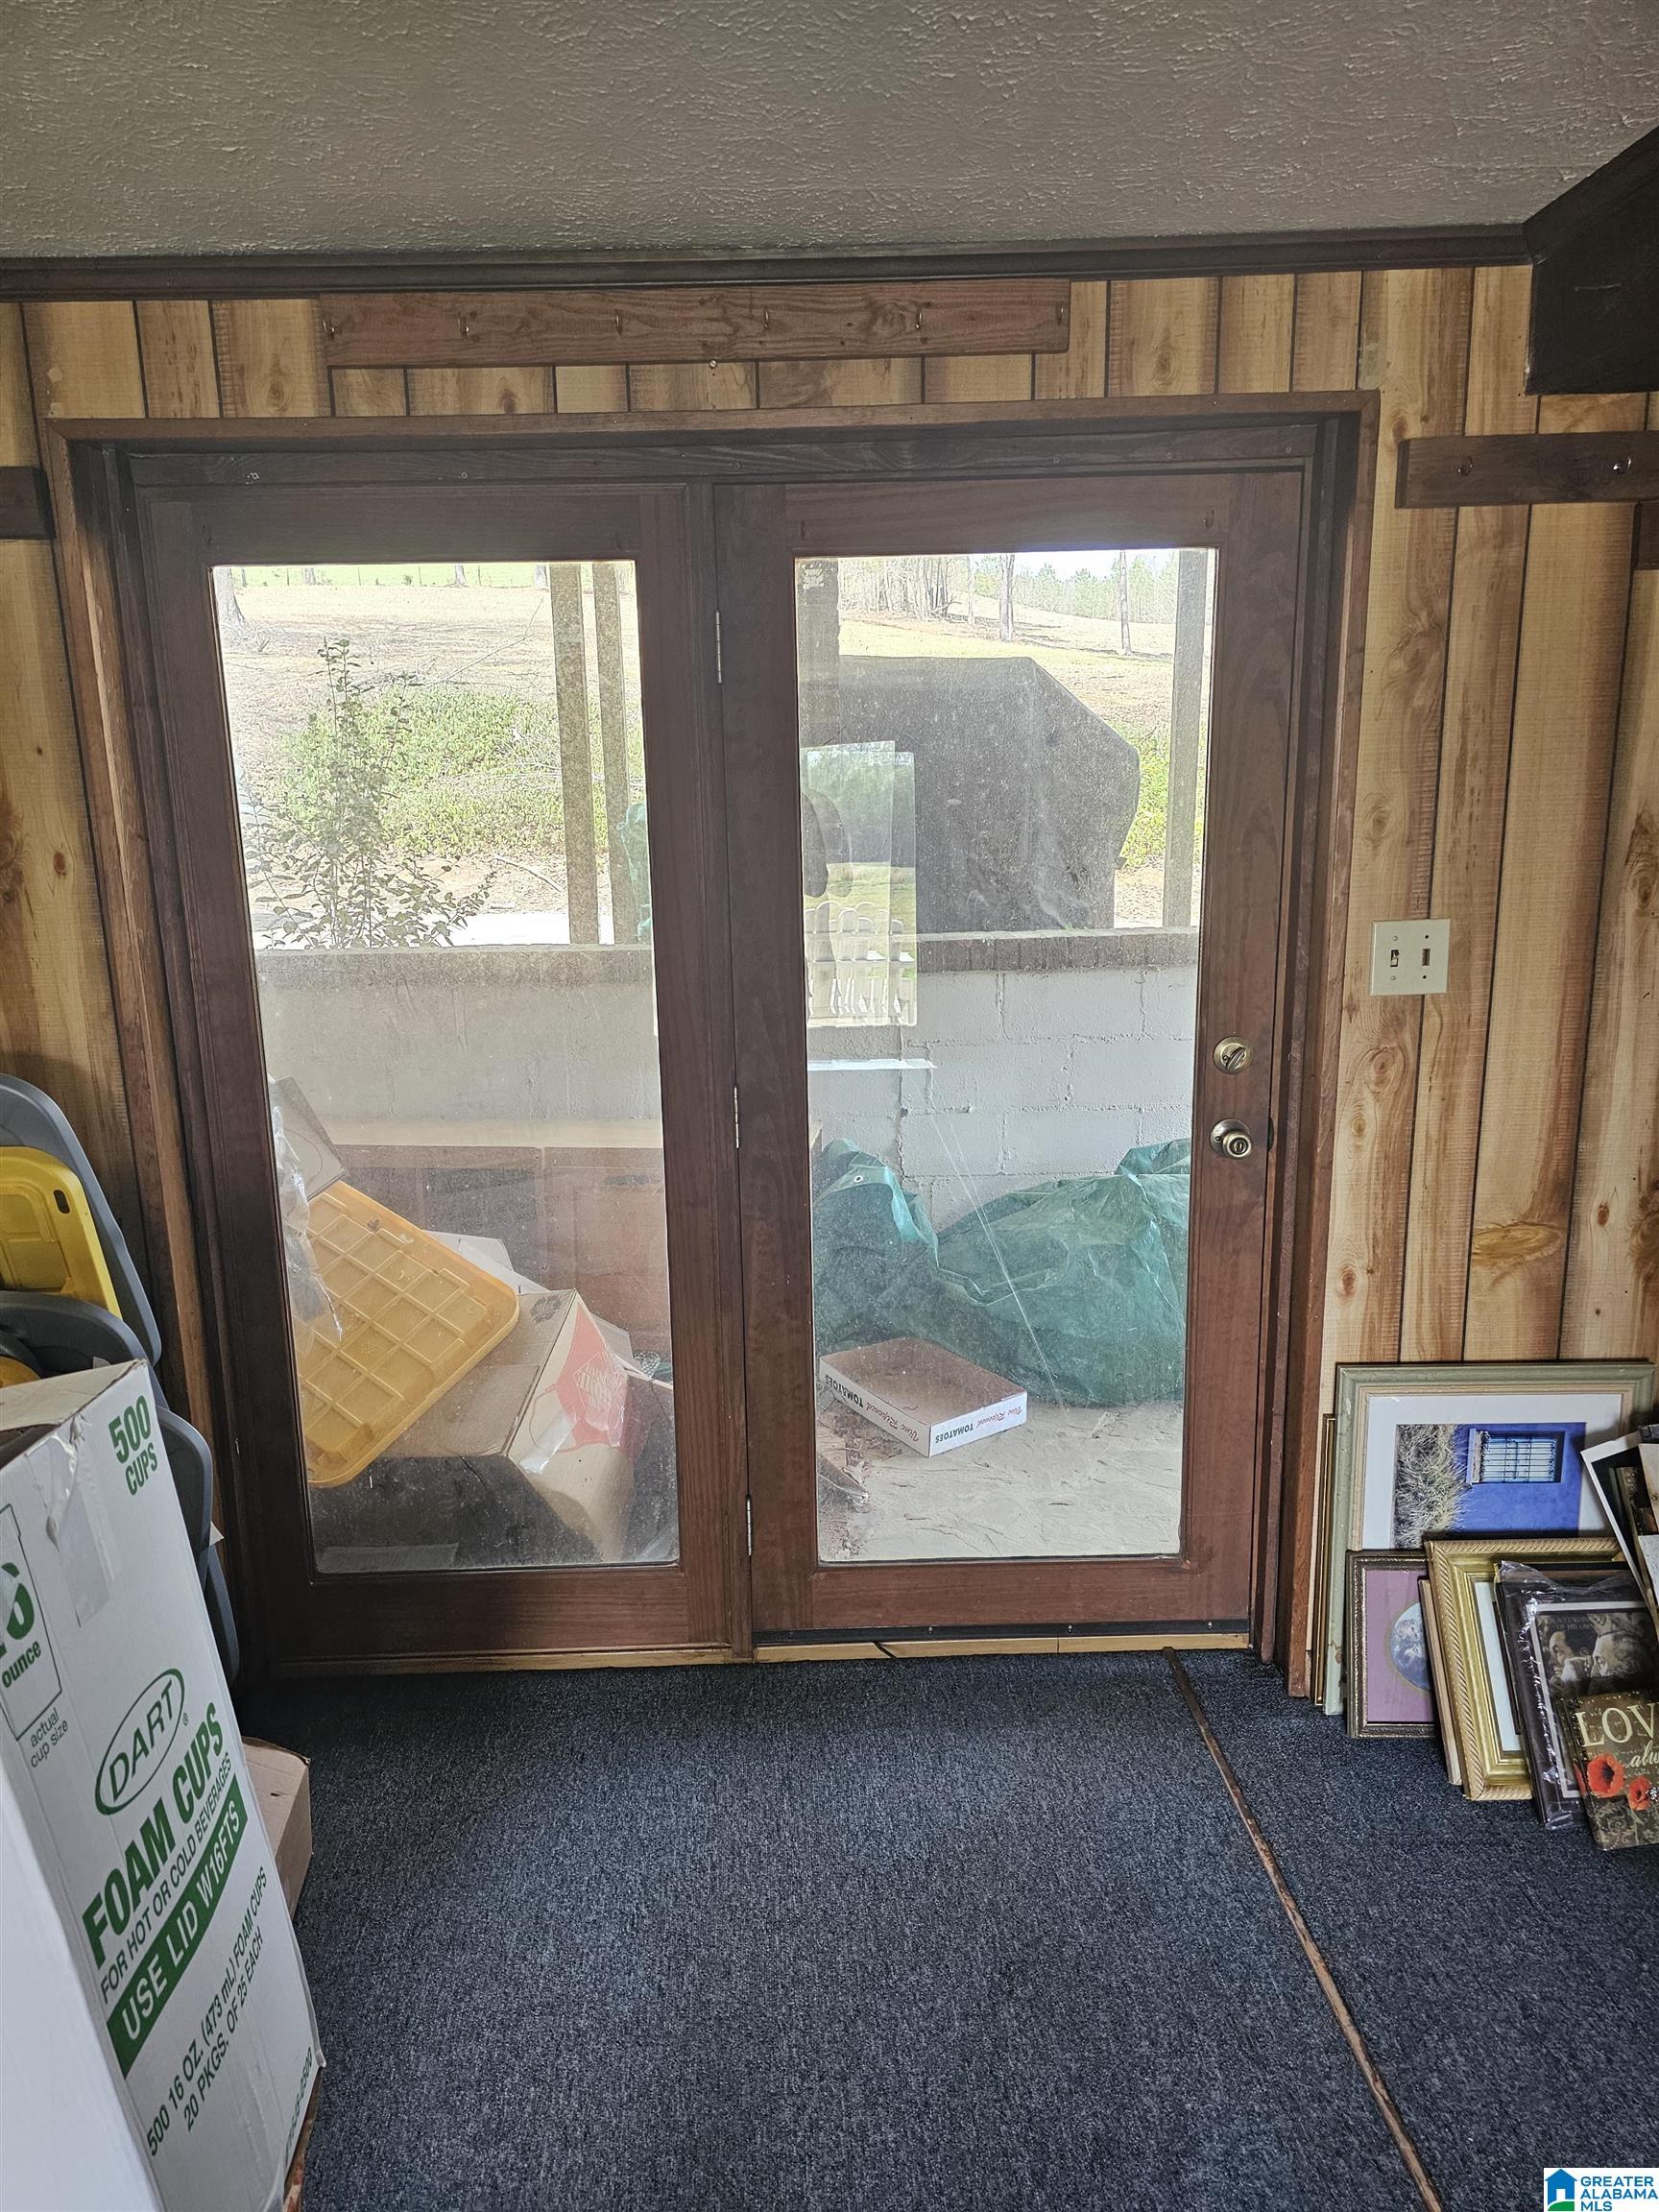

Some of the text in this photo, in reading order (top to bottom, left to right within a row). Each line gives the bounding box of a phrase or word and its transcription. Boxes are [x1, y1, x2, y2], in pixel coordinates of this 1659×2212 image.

[825, 1374, 863, 1407] TOMATOES
[108, 1395, 151, 1464] 500
[935, 1422, 974, 1444] TOMATOES
[125, 1442, 157, 1495] CUPS
[2, 1641, 41, 1688] ounce
[31, 1707, 60, 1747] actual
[31, 1719, 69, 1767] cup size
[109, 1679, 173, 1803] DART
[1575, 1701, 1659, 1747] LOV
[82, 1702, 223, 1970] FOAM CUPS
[101, 1751, 231, 2005] FOR HOT OR COLD BEVERAGES
[122, 1800, 239, 2040] USE LID W16FTS
[147, 2104, 170, 2156] 500
[169, 2075, 184, 2109] 16
[182, 2039, 204, 2081] OZ.
[201, 1994, 222, 2046] (473
[233, 1908, 253, 1968] FOAM
[251, 1866, 267, 1918] CUPS
[184, 1926, 263, 2131] 20 PKGS. OF 25 EACH
